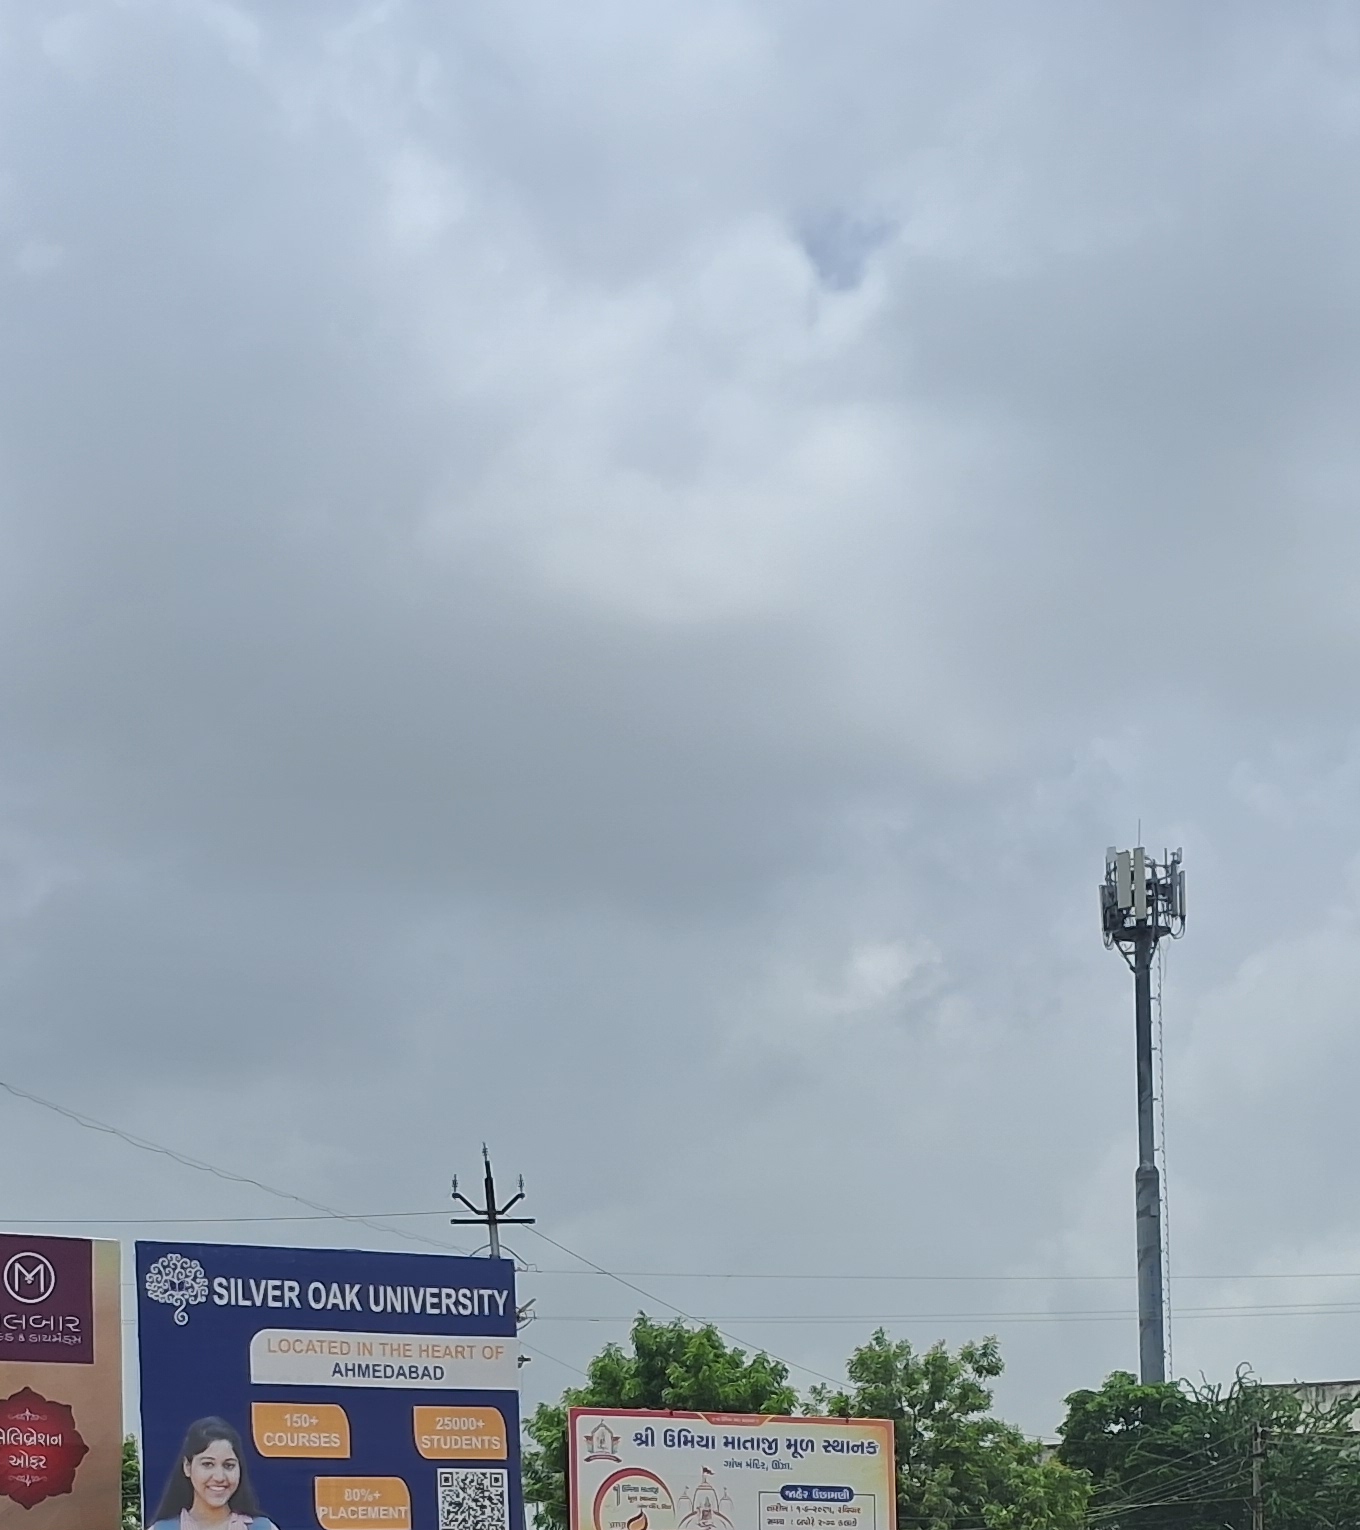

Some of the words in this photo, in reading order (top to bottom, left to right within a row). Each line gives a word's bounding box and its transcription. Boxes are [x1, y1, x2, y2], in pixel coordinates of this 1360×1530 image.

[212, 1276, 301, 1309] SILVER
[307, 1282, 362, 1311] OAK
[369, 1285, 509, 1316] UNIVERSITY
[267, 1338, 350, 1356] LOCATED
[357, 1341, 373, 1357] IN
[379, 1342, 413, 1358] THE
[418, 1344, 476, 1360] HEART
[481, 1345, 504, 1360] OF
[331, 1362, 445, 1381] AHMEDABAD
[284, 1413, 319, 1428] 150+
[435, 1417, 486, 1431] 25000+
[264, 1432, 341, 1448] COURSES
[421, 1435, 501, 1450] STUDENTS
[632, 1426, 654, 1448] શ્રી
[663, 1427, 716, 1450] ઉમિયા
[723, 1434, 778, 1455] માતાજી
[785, 1436, 814, 1459] મૂળ
[822, 1438, 879, 1455] સ્થાનક
[8, 1449, 47, 1469] ઓફર
[320, 1505, 409, 1520] PLACEMENT
